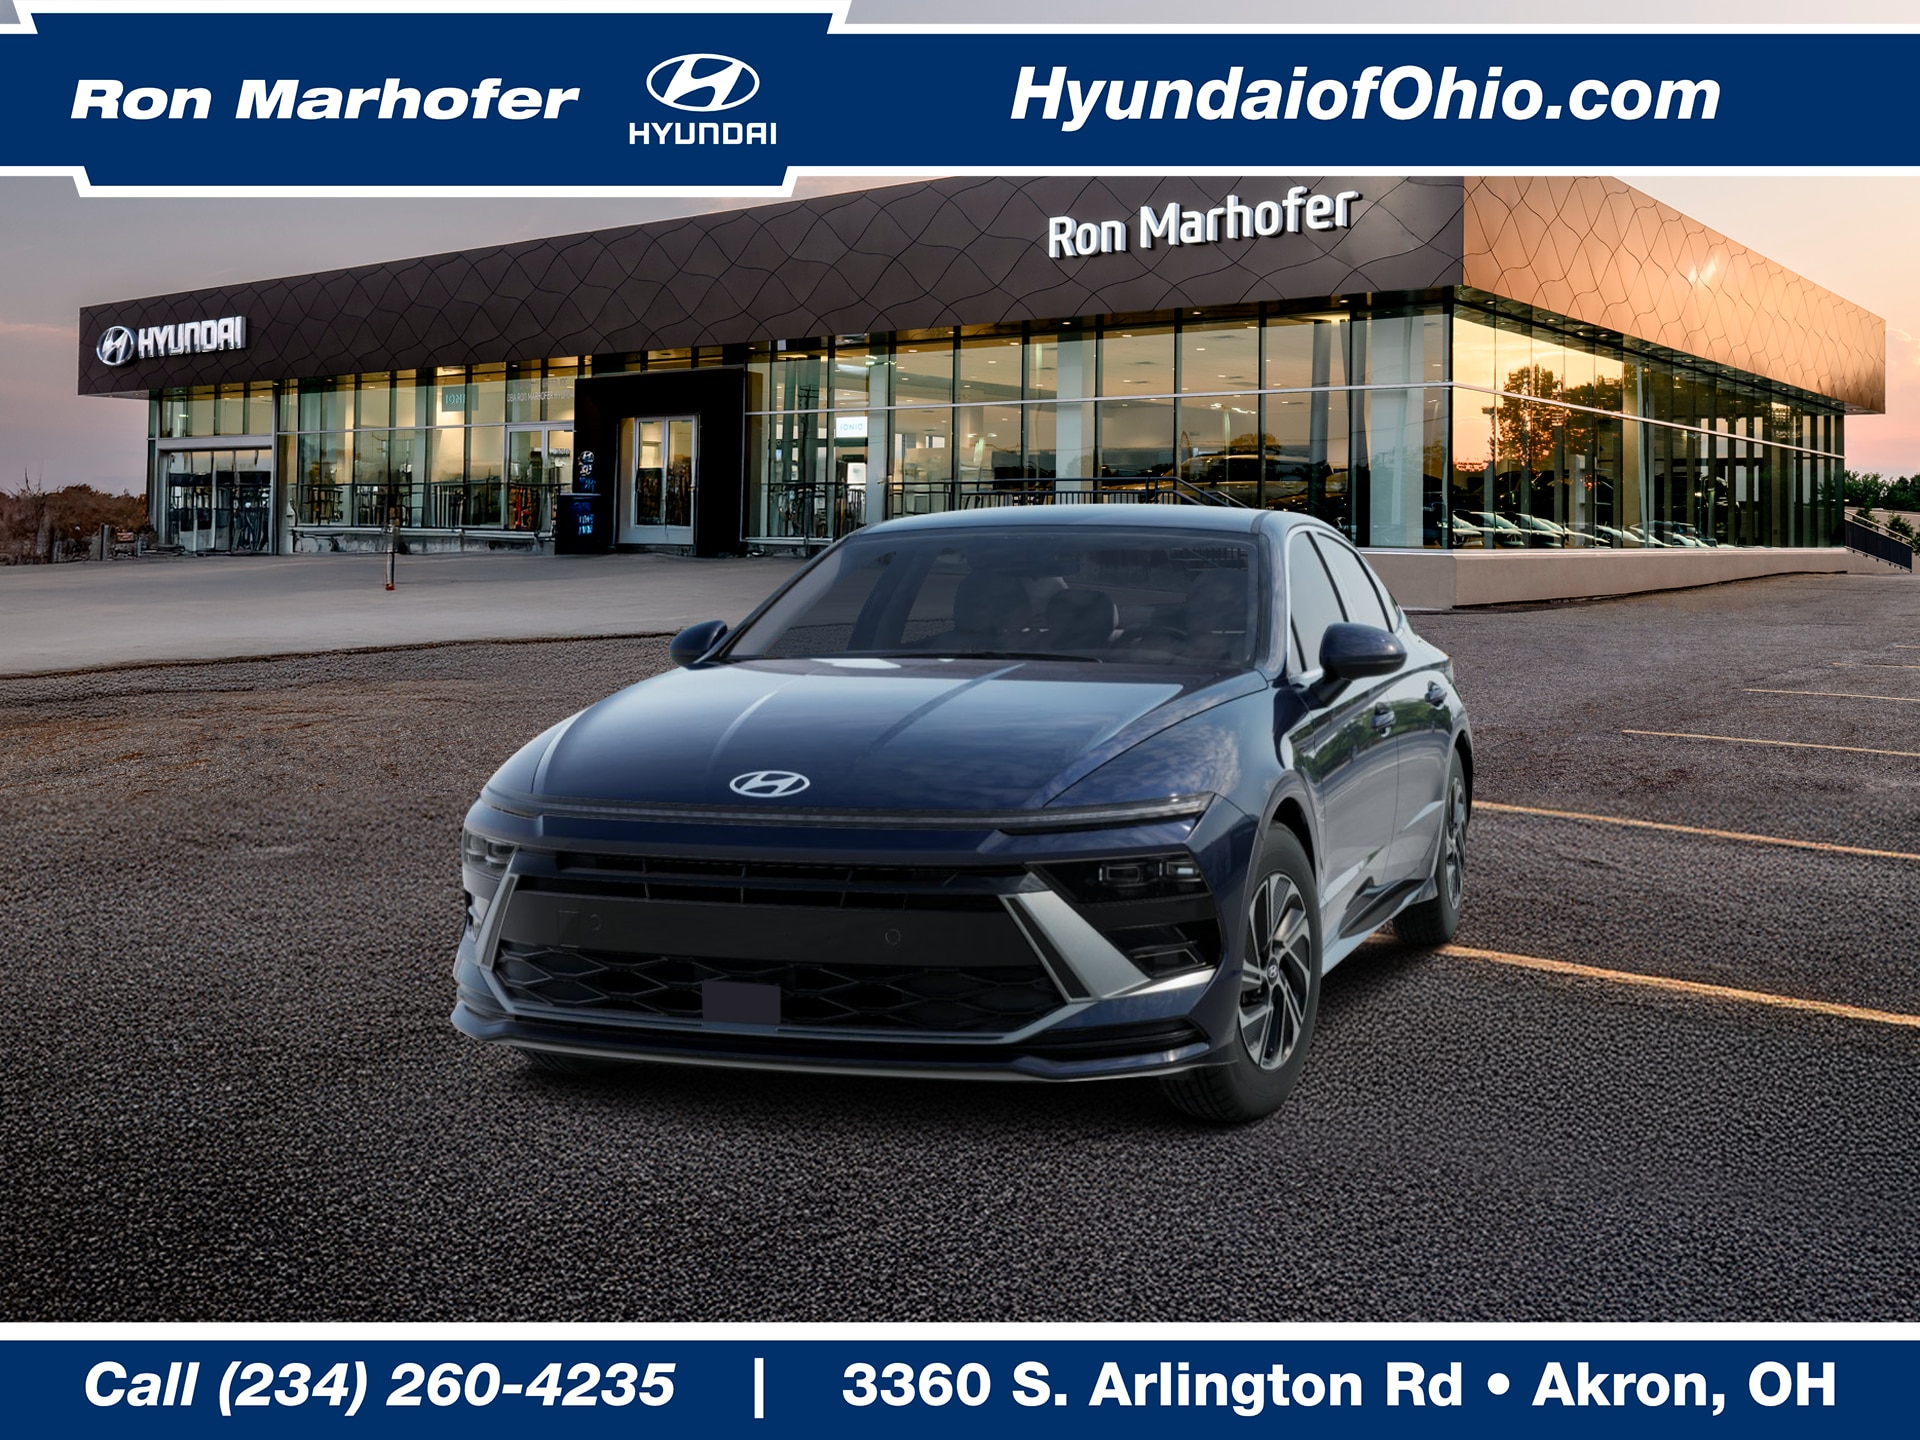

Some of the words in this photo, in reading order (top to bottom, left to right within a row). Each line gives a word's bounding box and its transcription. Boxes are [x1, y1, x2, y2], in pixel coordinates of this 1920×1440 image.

[1049, 216, 1127, 259] Ron
[1140, 186, 1360, 249] Marhofer
[138, 316, 246, 359] HYUNDAI
